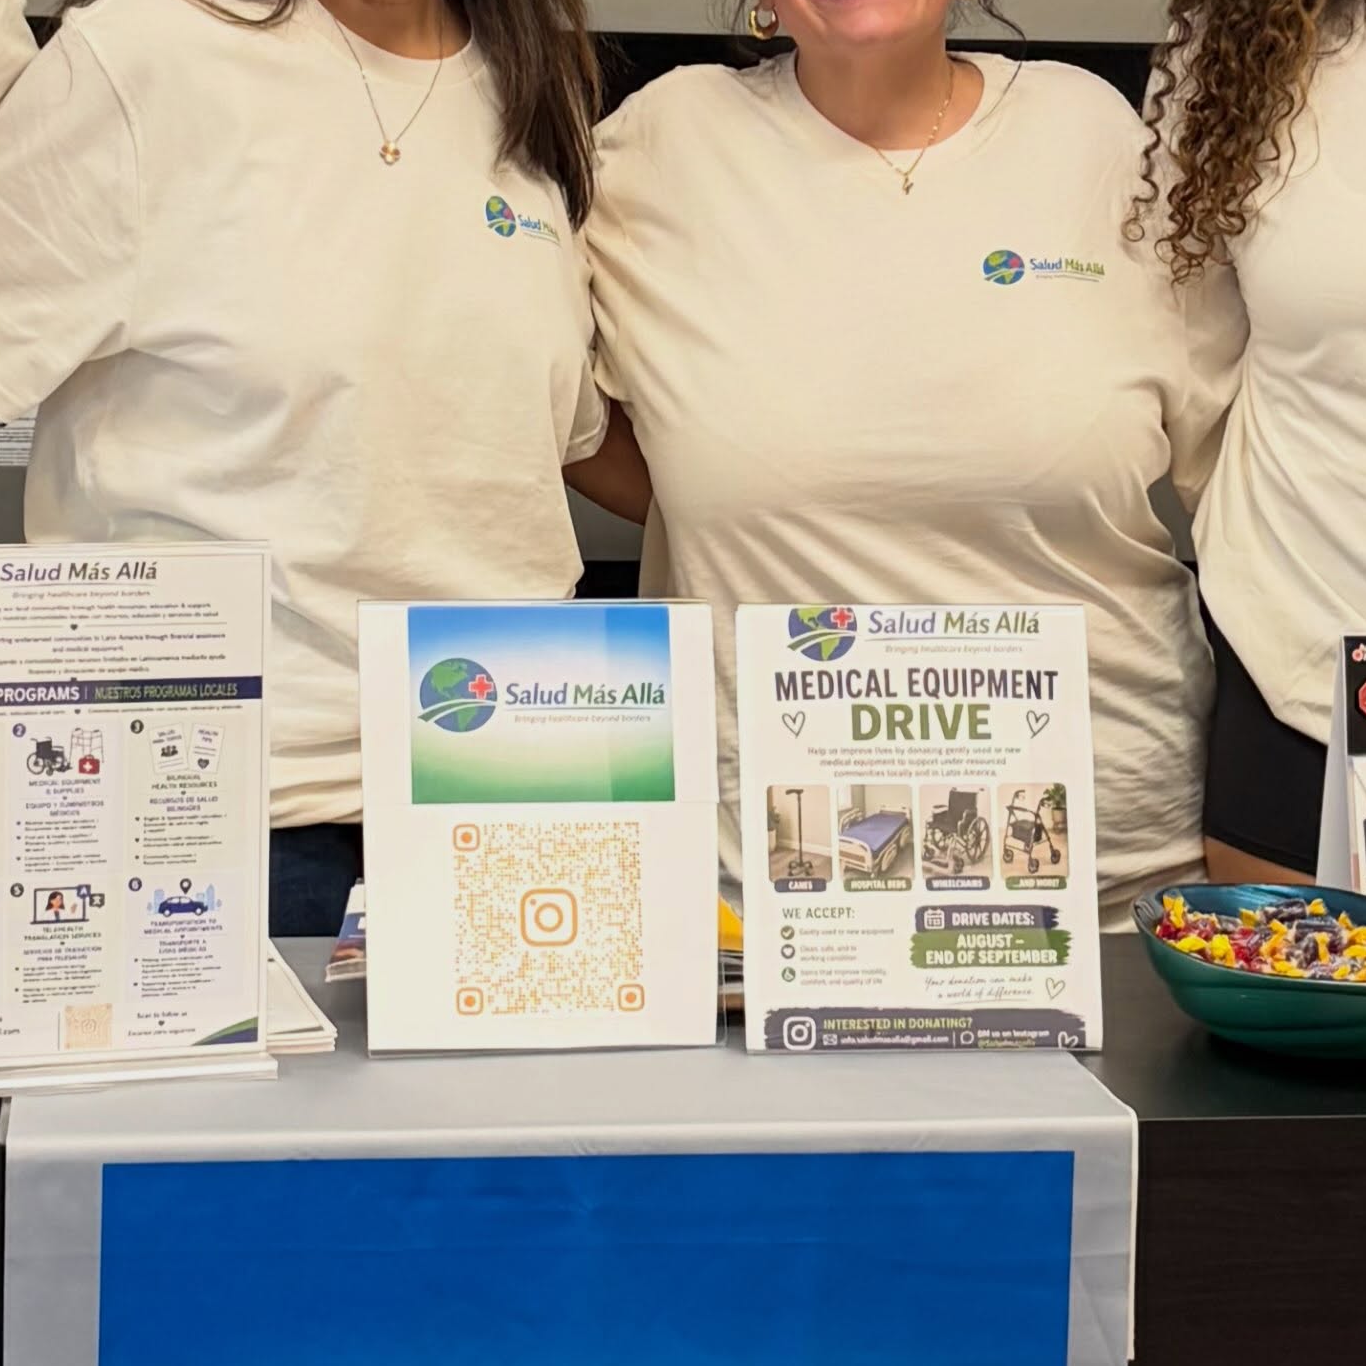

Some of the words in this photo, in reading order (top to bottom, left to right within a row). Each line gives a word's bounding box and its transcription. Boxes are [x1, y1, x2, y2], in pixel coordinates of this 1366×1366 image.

[1030, 258, 1062, 270] Salud
[0, 563, 61, 582] Salud
[68, 562, 111, 581] Más
[116, 561, 157, 580] Allá
[868, 611, 935, 634] Salud
[943, 611, 989, 633] Más
[995, 611, 1039, 633] Allá
[95, 687, 141, 700] NUESTROS
[143, 685, 197, 699] PROGRAMAS
[200, 683, 238, 697] LOCALES
[775, 669, 897, 701] MEDICAL
[907, 668, 1058, 700] EQUIPMENT
[505, 683, 568, 705] Salud
[573, 684, 616, 705] Más
[621, 683, 665, 705] Allá
[851, 704, 992, 741] DRIVE
[782, 908, 801, 919] WE
[806, 907, 855, 919] ACCEPT:
[952, 912, 990, 926] DRIVE
[992, 912, 1035, 925] DATES:
[957, 934, 1013, 948] AUGUST
[926, 950, 954, 964] END
[957, 950, 976, 964] OF
[979, 950, 1057, 964] SEPTEMBER
[823, 1018, 891, 1030] INTERESTED
[894, 1019, 906, 1029] IN
[909, 1017, 973, 1029] DONATING?
